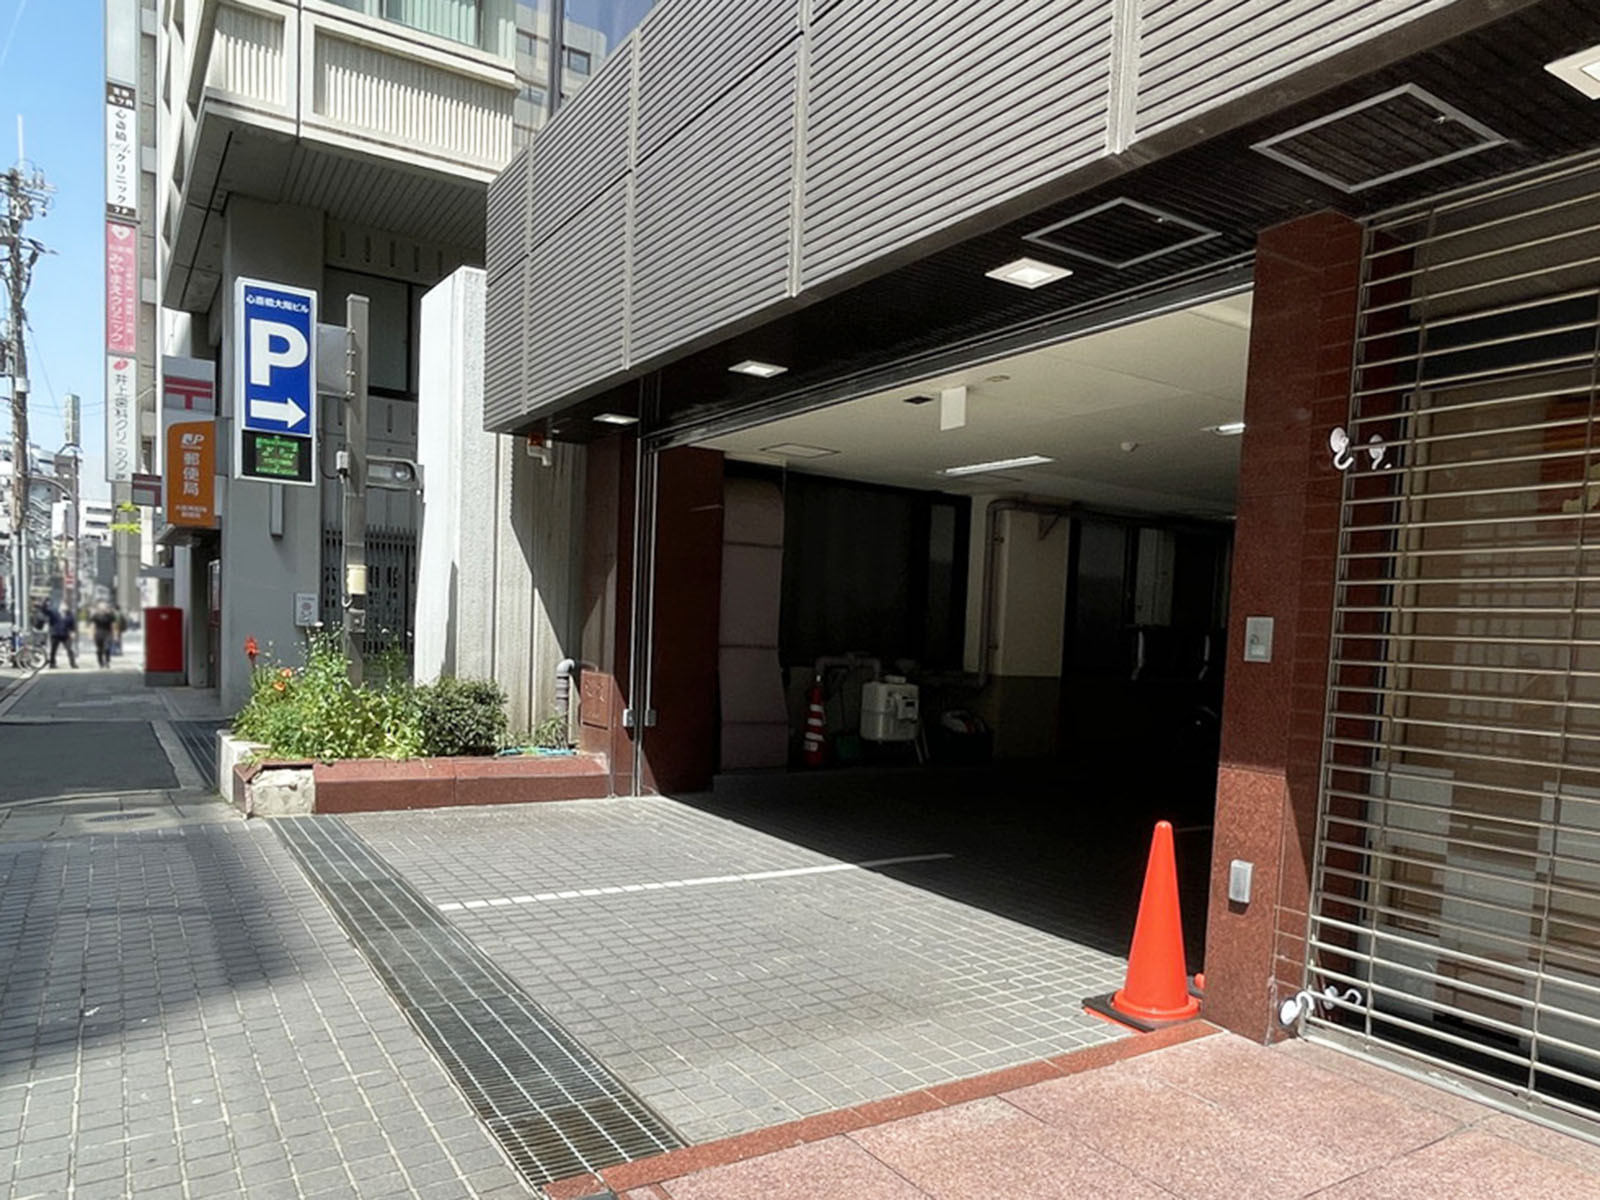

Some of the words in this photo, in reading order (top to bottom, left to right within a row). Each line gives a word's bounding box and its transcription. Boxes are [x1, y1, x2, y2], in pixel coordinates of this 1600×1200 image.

[250, 318, 308, 387] P
[183, 452, 200, 497] 郵便局
